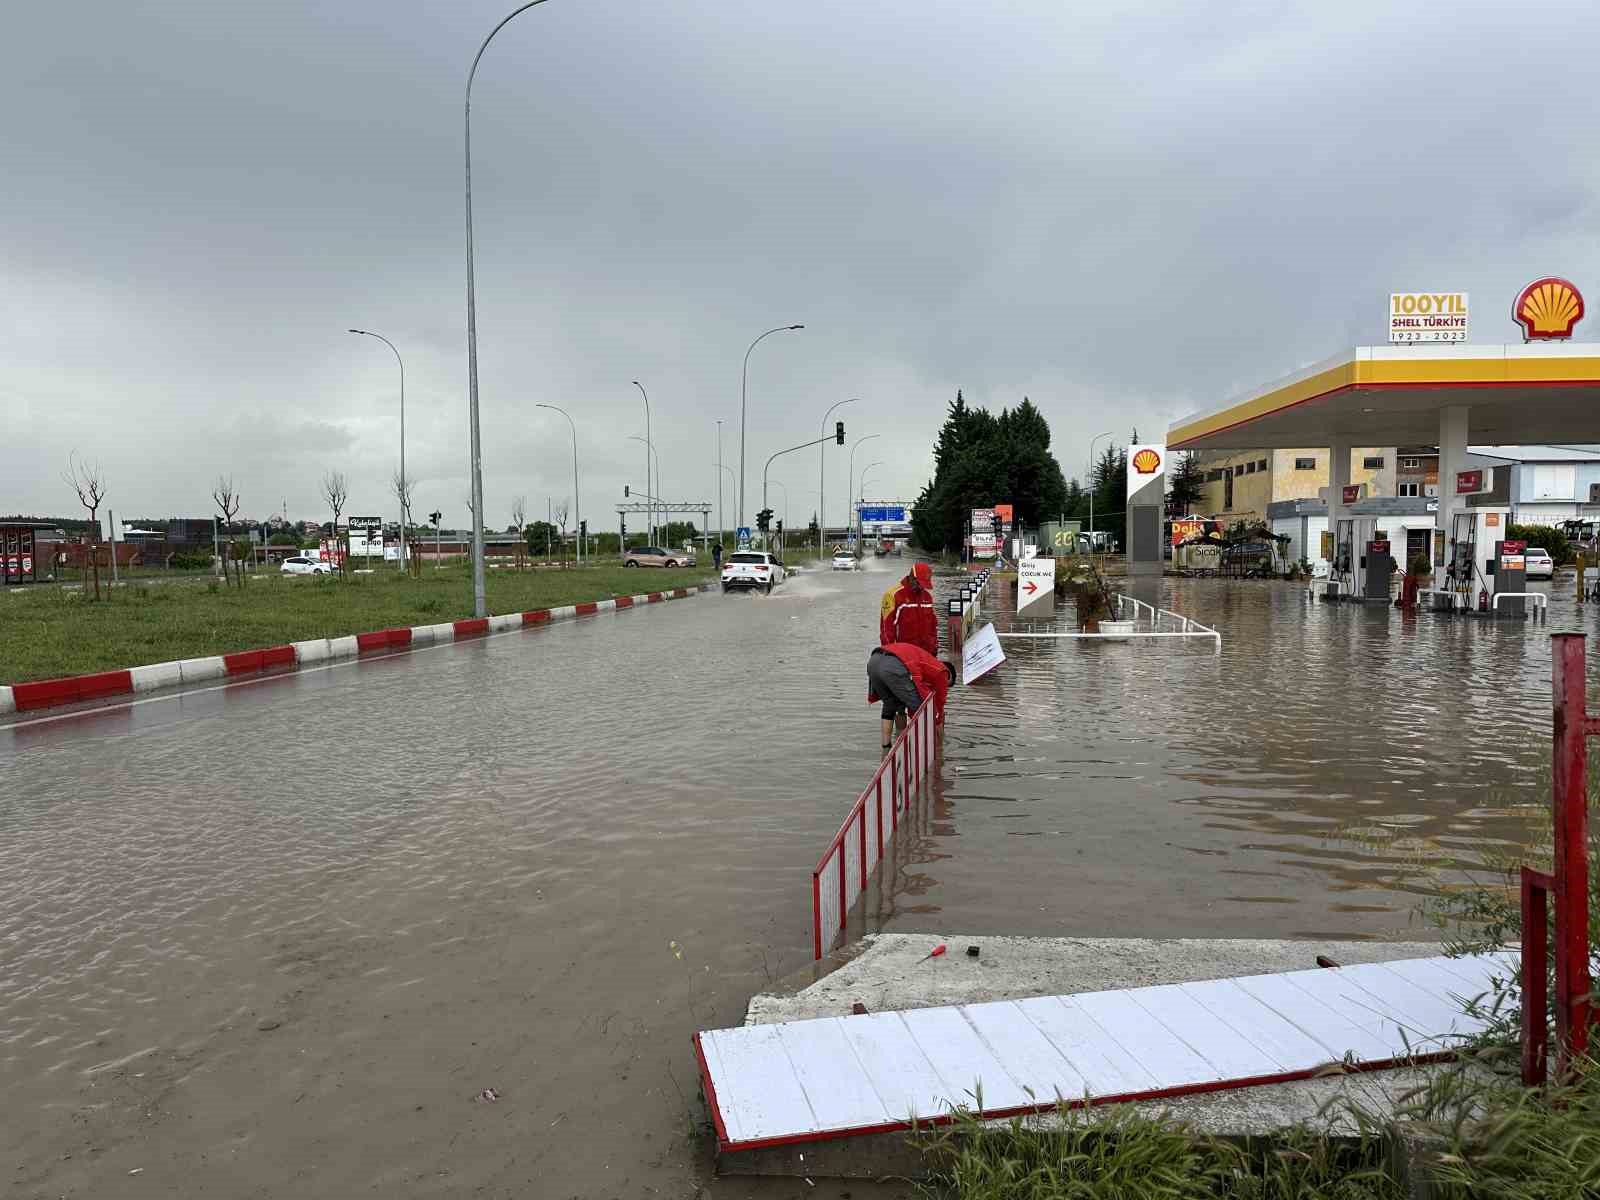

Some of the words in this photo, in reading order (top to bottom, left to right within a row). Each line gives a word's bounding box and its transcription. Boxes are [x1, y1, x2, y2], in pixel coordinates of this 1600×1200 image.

[1392, 295, 1466, 313] 100YIL
[1392, 318, 1421, 327] SHELL
[1423, 315, 1466, 327] TÜRKİYE
